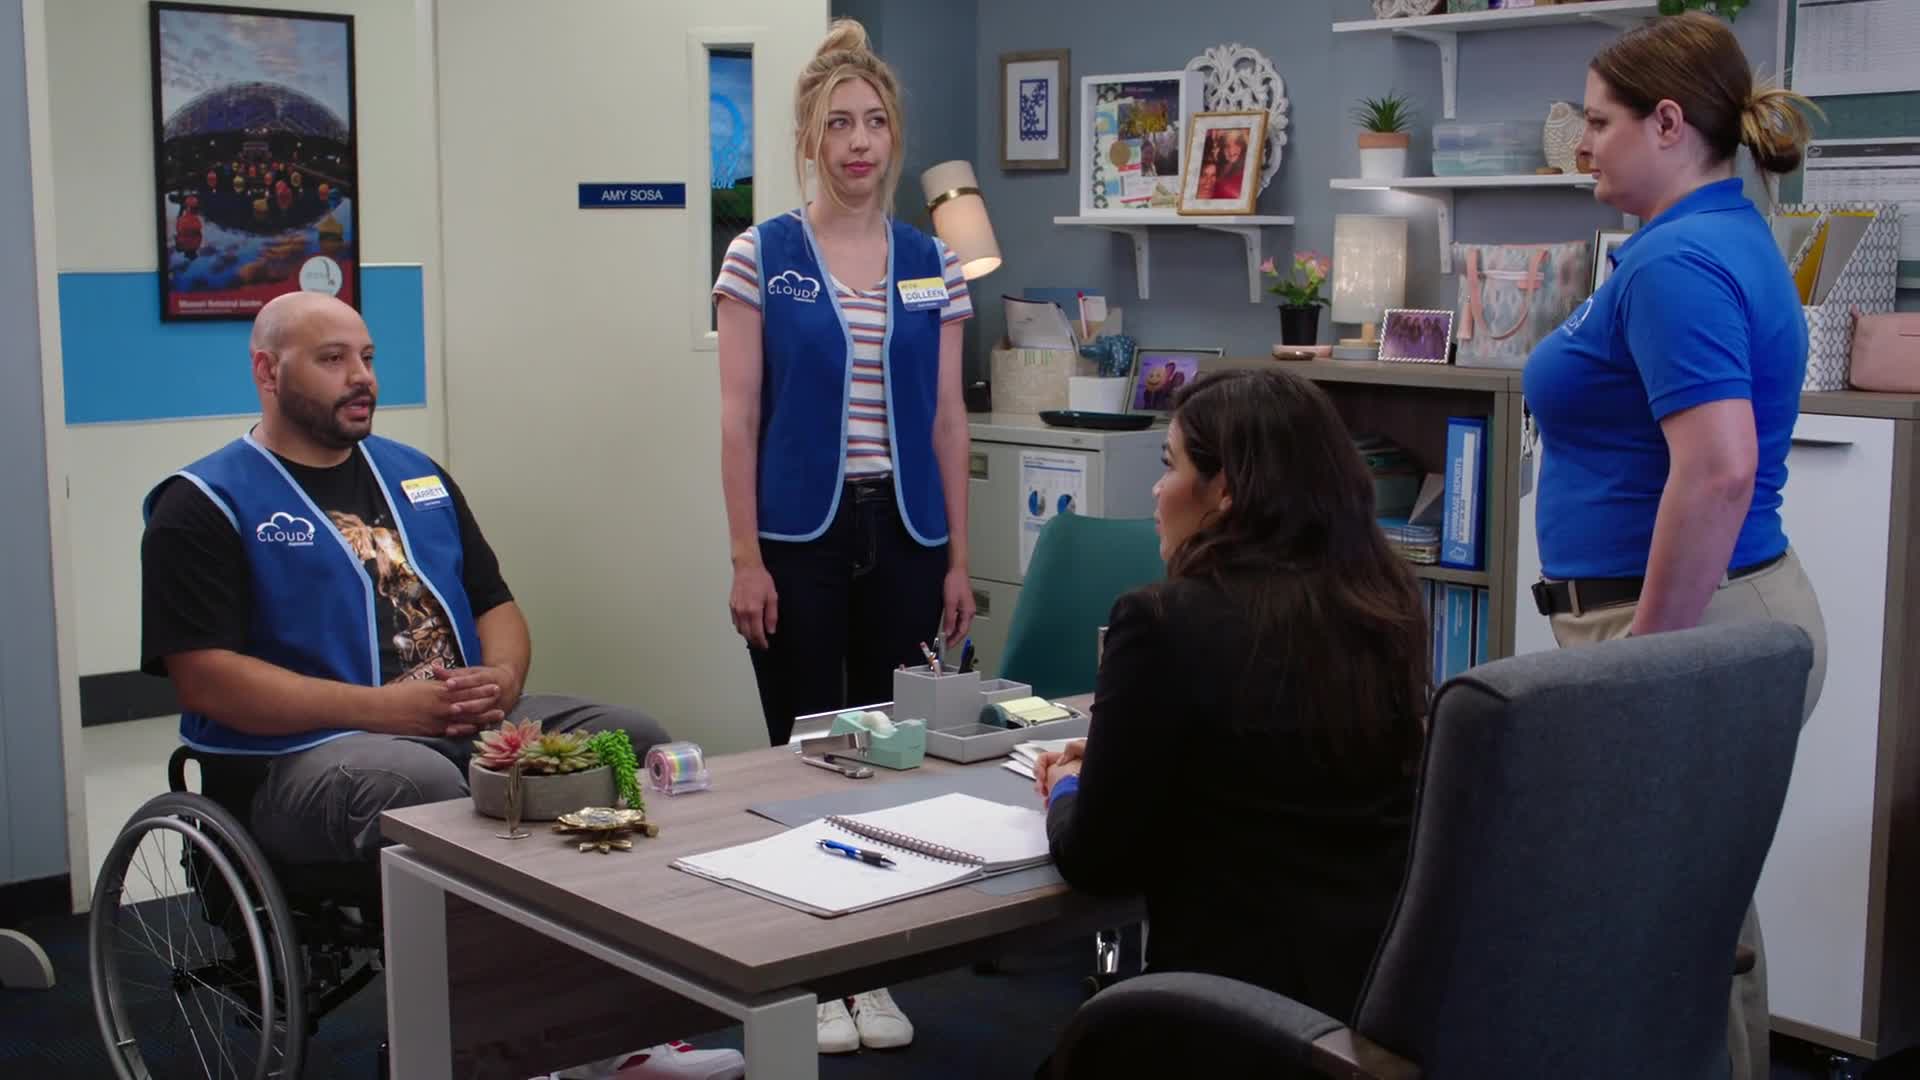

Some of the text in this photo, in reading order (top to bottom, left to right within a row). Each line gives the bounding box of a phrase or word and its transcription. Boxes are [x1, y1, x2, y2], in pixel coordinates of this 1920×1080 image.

[601, 189, 663, 201] AMY SOSA
[905, 289, 945, 301] COLLEEN
[411, 487, 445, 500] GARRETT
